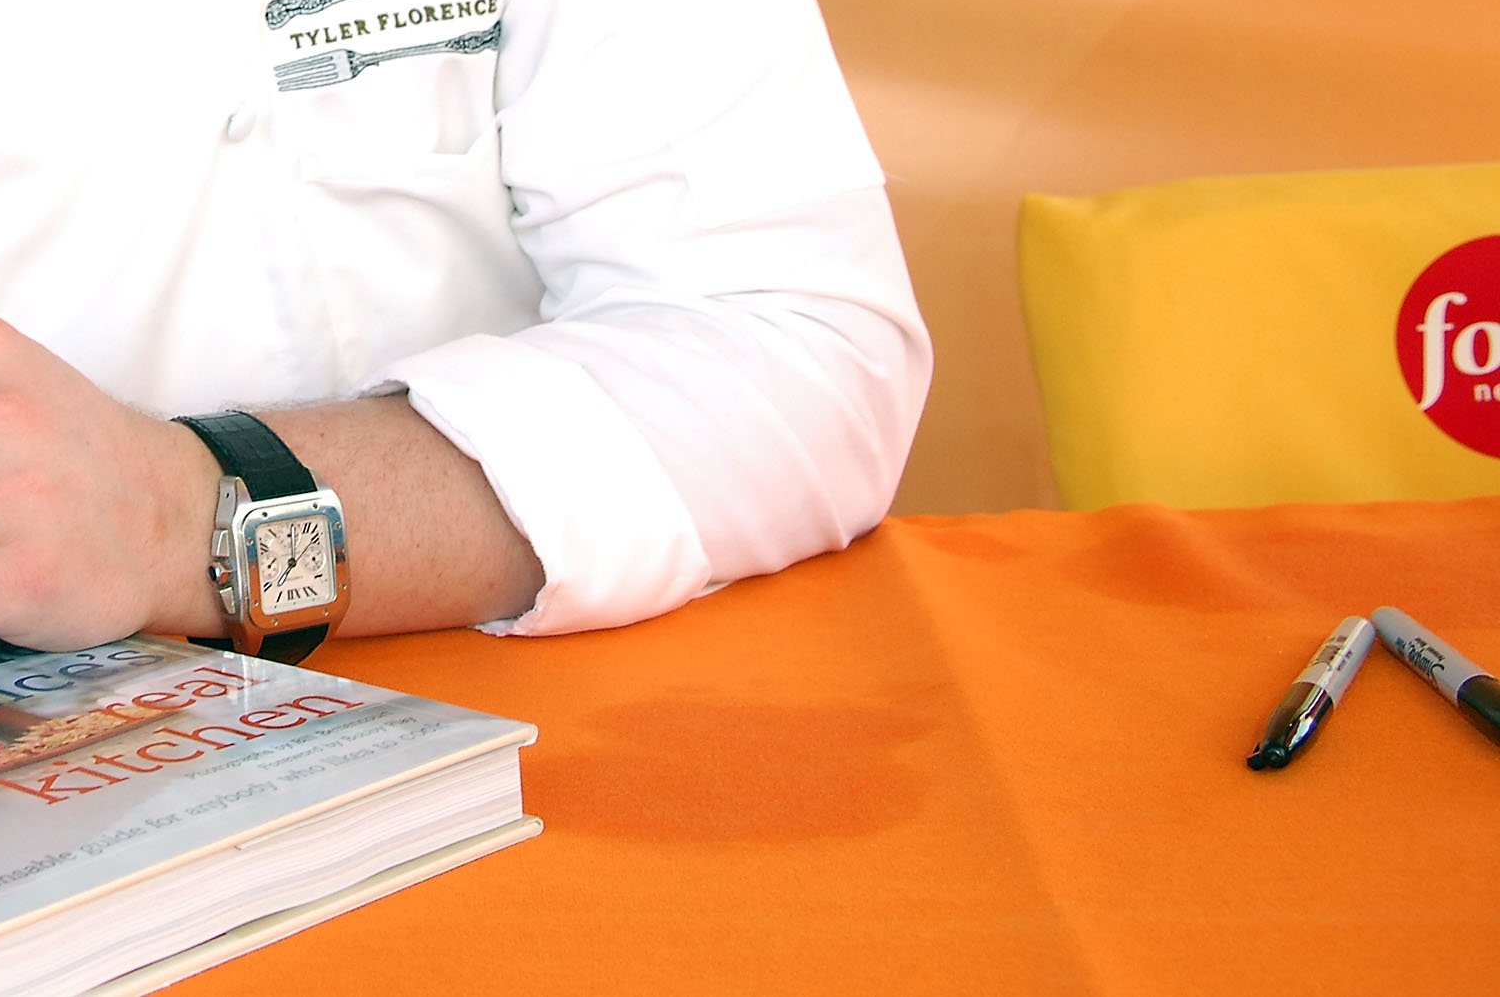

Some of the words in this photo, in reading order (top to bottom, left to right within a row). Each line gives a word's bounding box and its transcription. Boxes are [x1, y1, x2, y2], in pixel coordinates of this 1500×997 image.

[290, 18, 371, 50] TYLER
[1416, 292, 1500, 411] fo
[88, 667, 270, 724] real
[79, 824, 148, 857] guide
[145, 809, 183, 831] for
[184, 780, 278, 817] anybody
[277, 763, 326, 783] who
